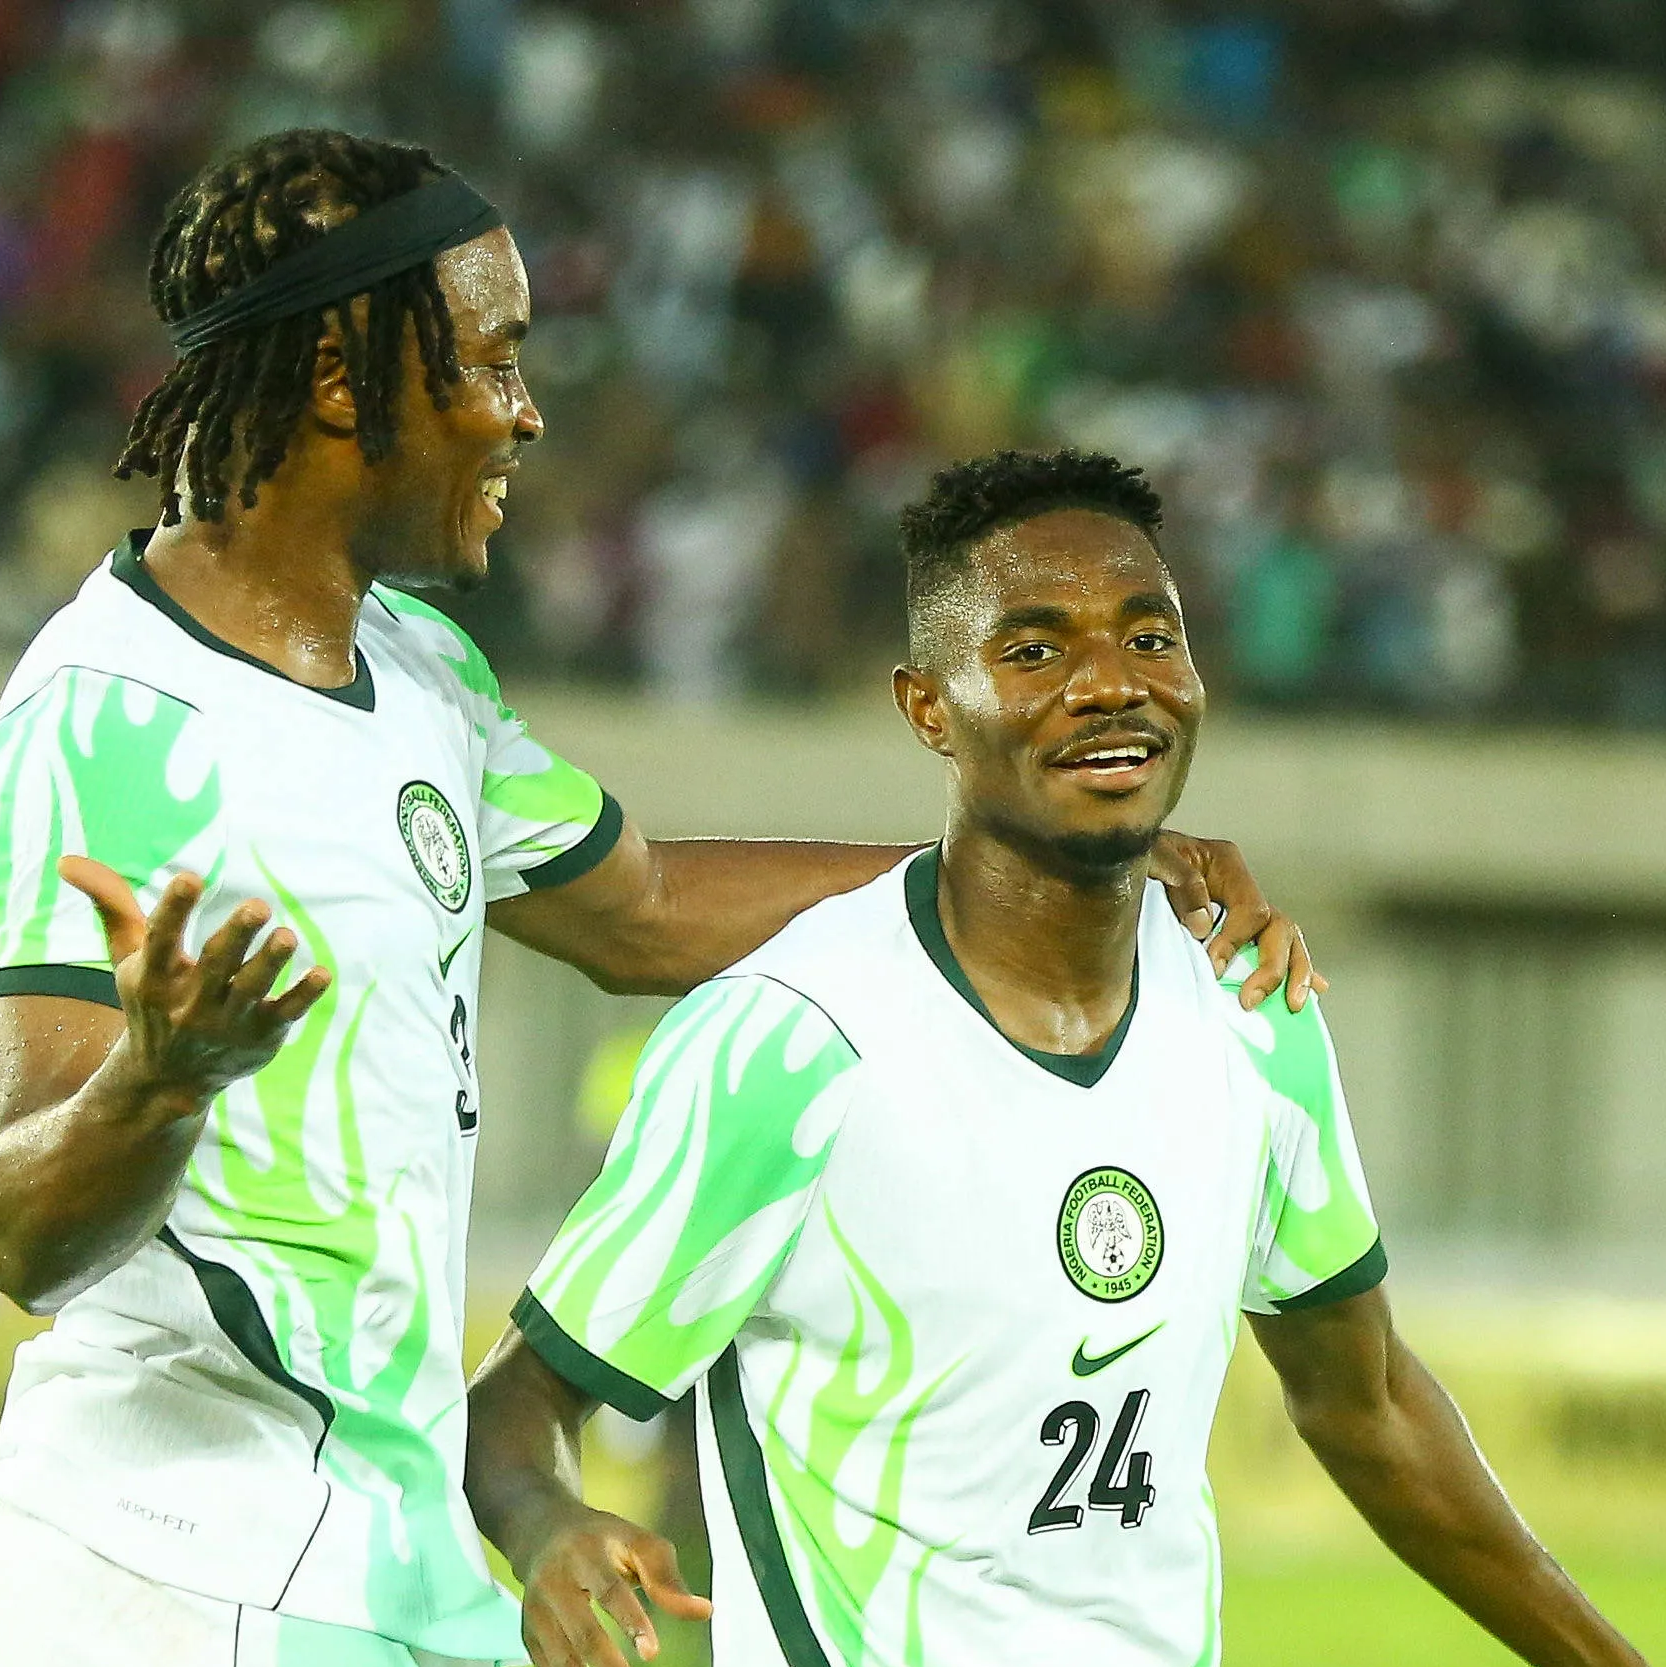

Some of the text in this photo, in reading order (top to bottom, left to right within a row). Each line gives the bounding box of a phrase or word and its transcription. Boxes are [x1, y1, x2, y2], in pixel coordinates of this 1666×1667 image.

[1063, 1175, 1158, 1282] NIGERIA FOOTBALL FEDERATION
[1104, 1277, 1132, 1294] 1945
[1026, 1388, 1157, 1536] 24
